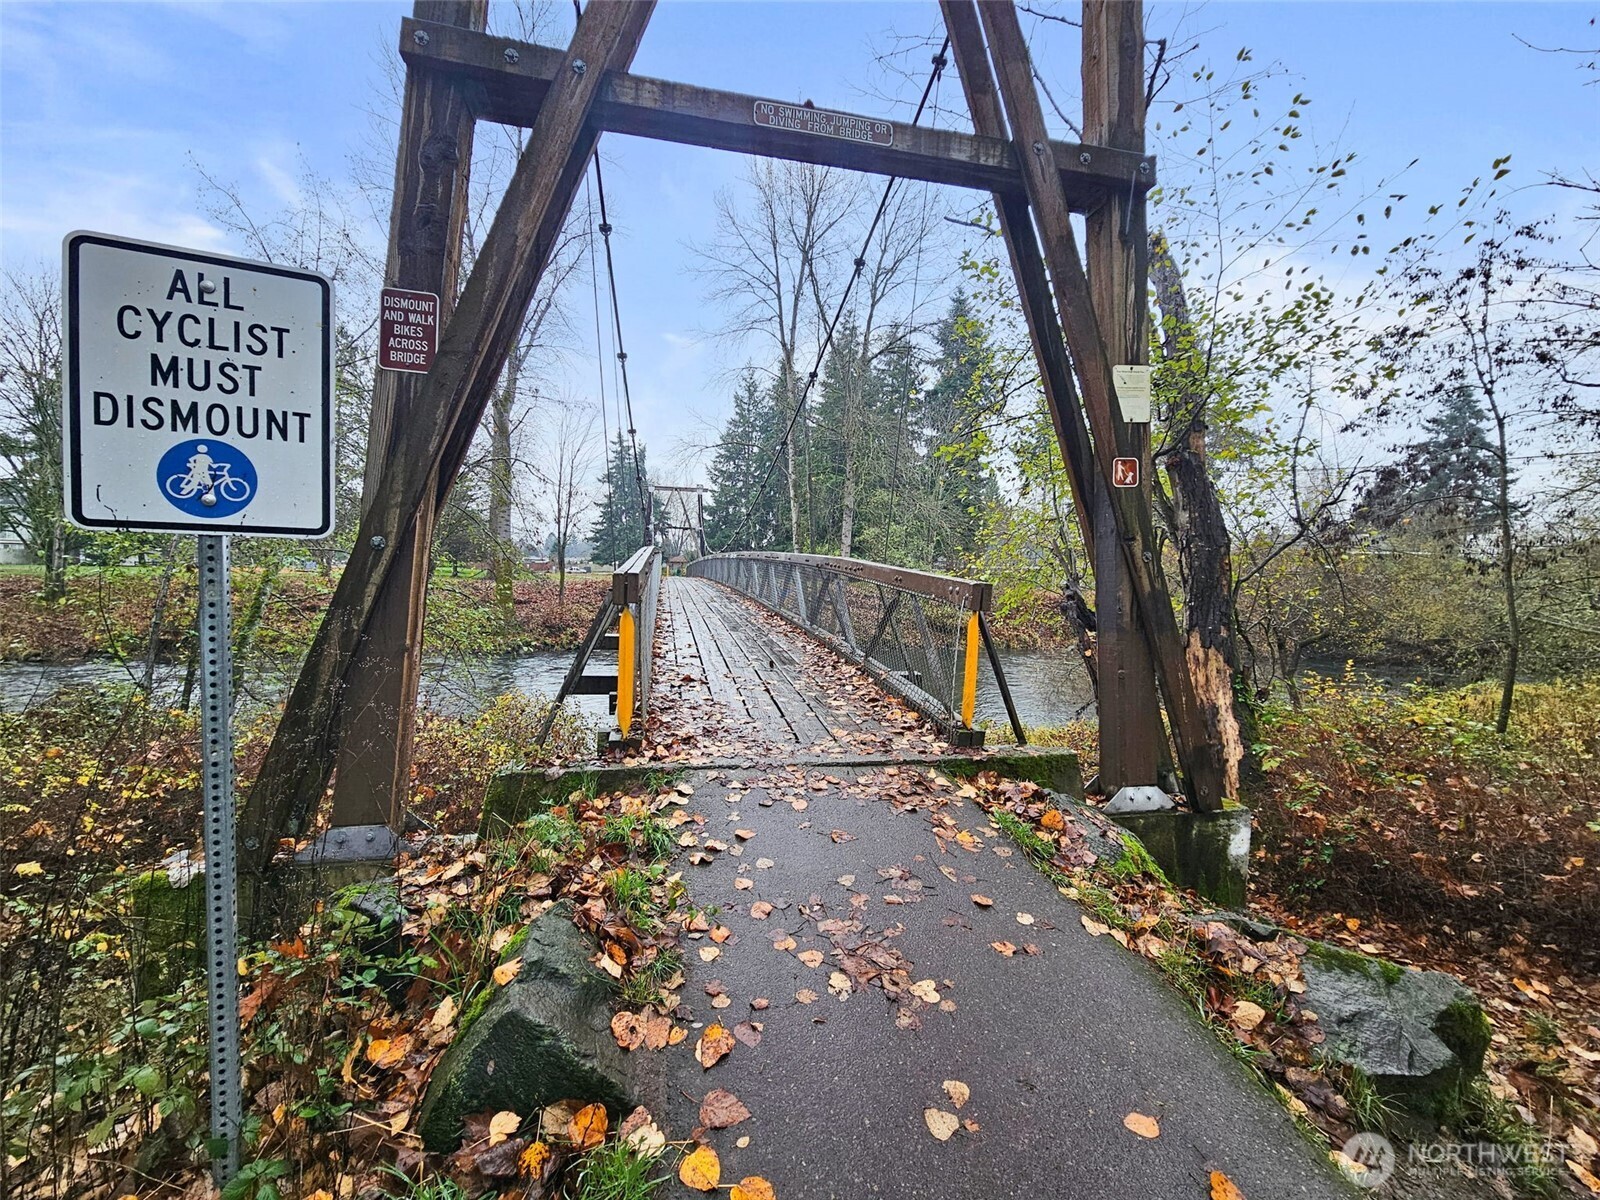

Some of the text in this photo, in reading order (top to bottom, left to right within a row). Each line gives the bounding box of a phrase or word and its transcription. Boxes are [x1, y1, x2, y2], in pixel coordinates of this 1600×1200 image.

[760, 103, 775, 115] NO
[830, 116, 871, 131] JUMPING
[874, 123, 887, 134] OR
[769, 115, 873, 141] DIVING FROM BRIDGE
[166, 269, 245, 311] ALL
[383, 296, 435, 312] DISMOUNT
[383, 309, 434, 326] AND WALK
[117, 304, 290, 358] CYCLIST
[393, 324, 423, 338] BIKES
[388, 337, 429, 352] ACROSS
[390, 350, 427, 365] BRIDGE
[150, 353, 262, 397] MUST
[93, 391, 311, 443] DISMOUNT
